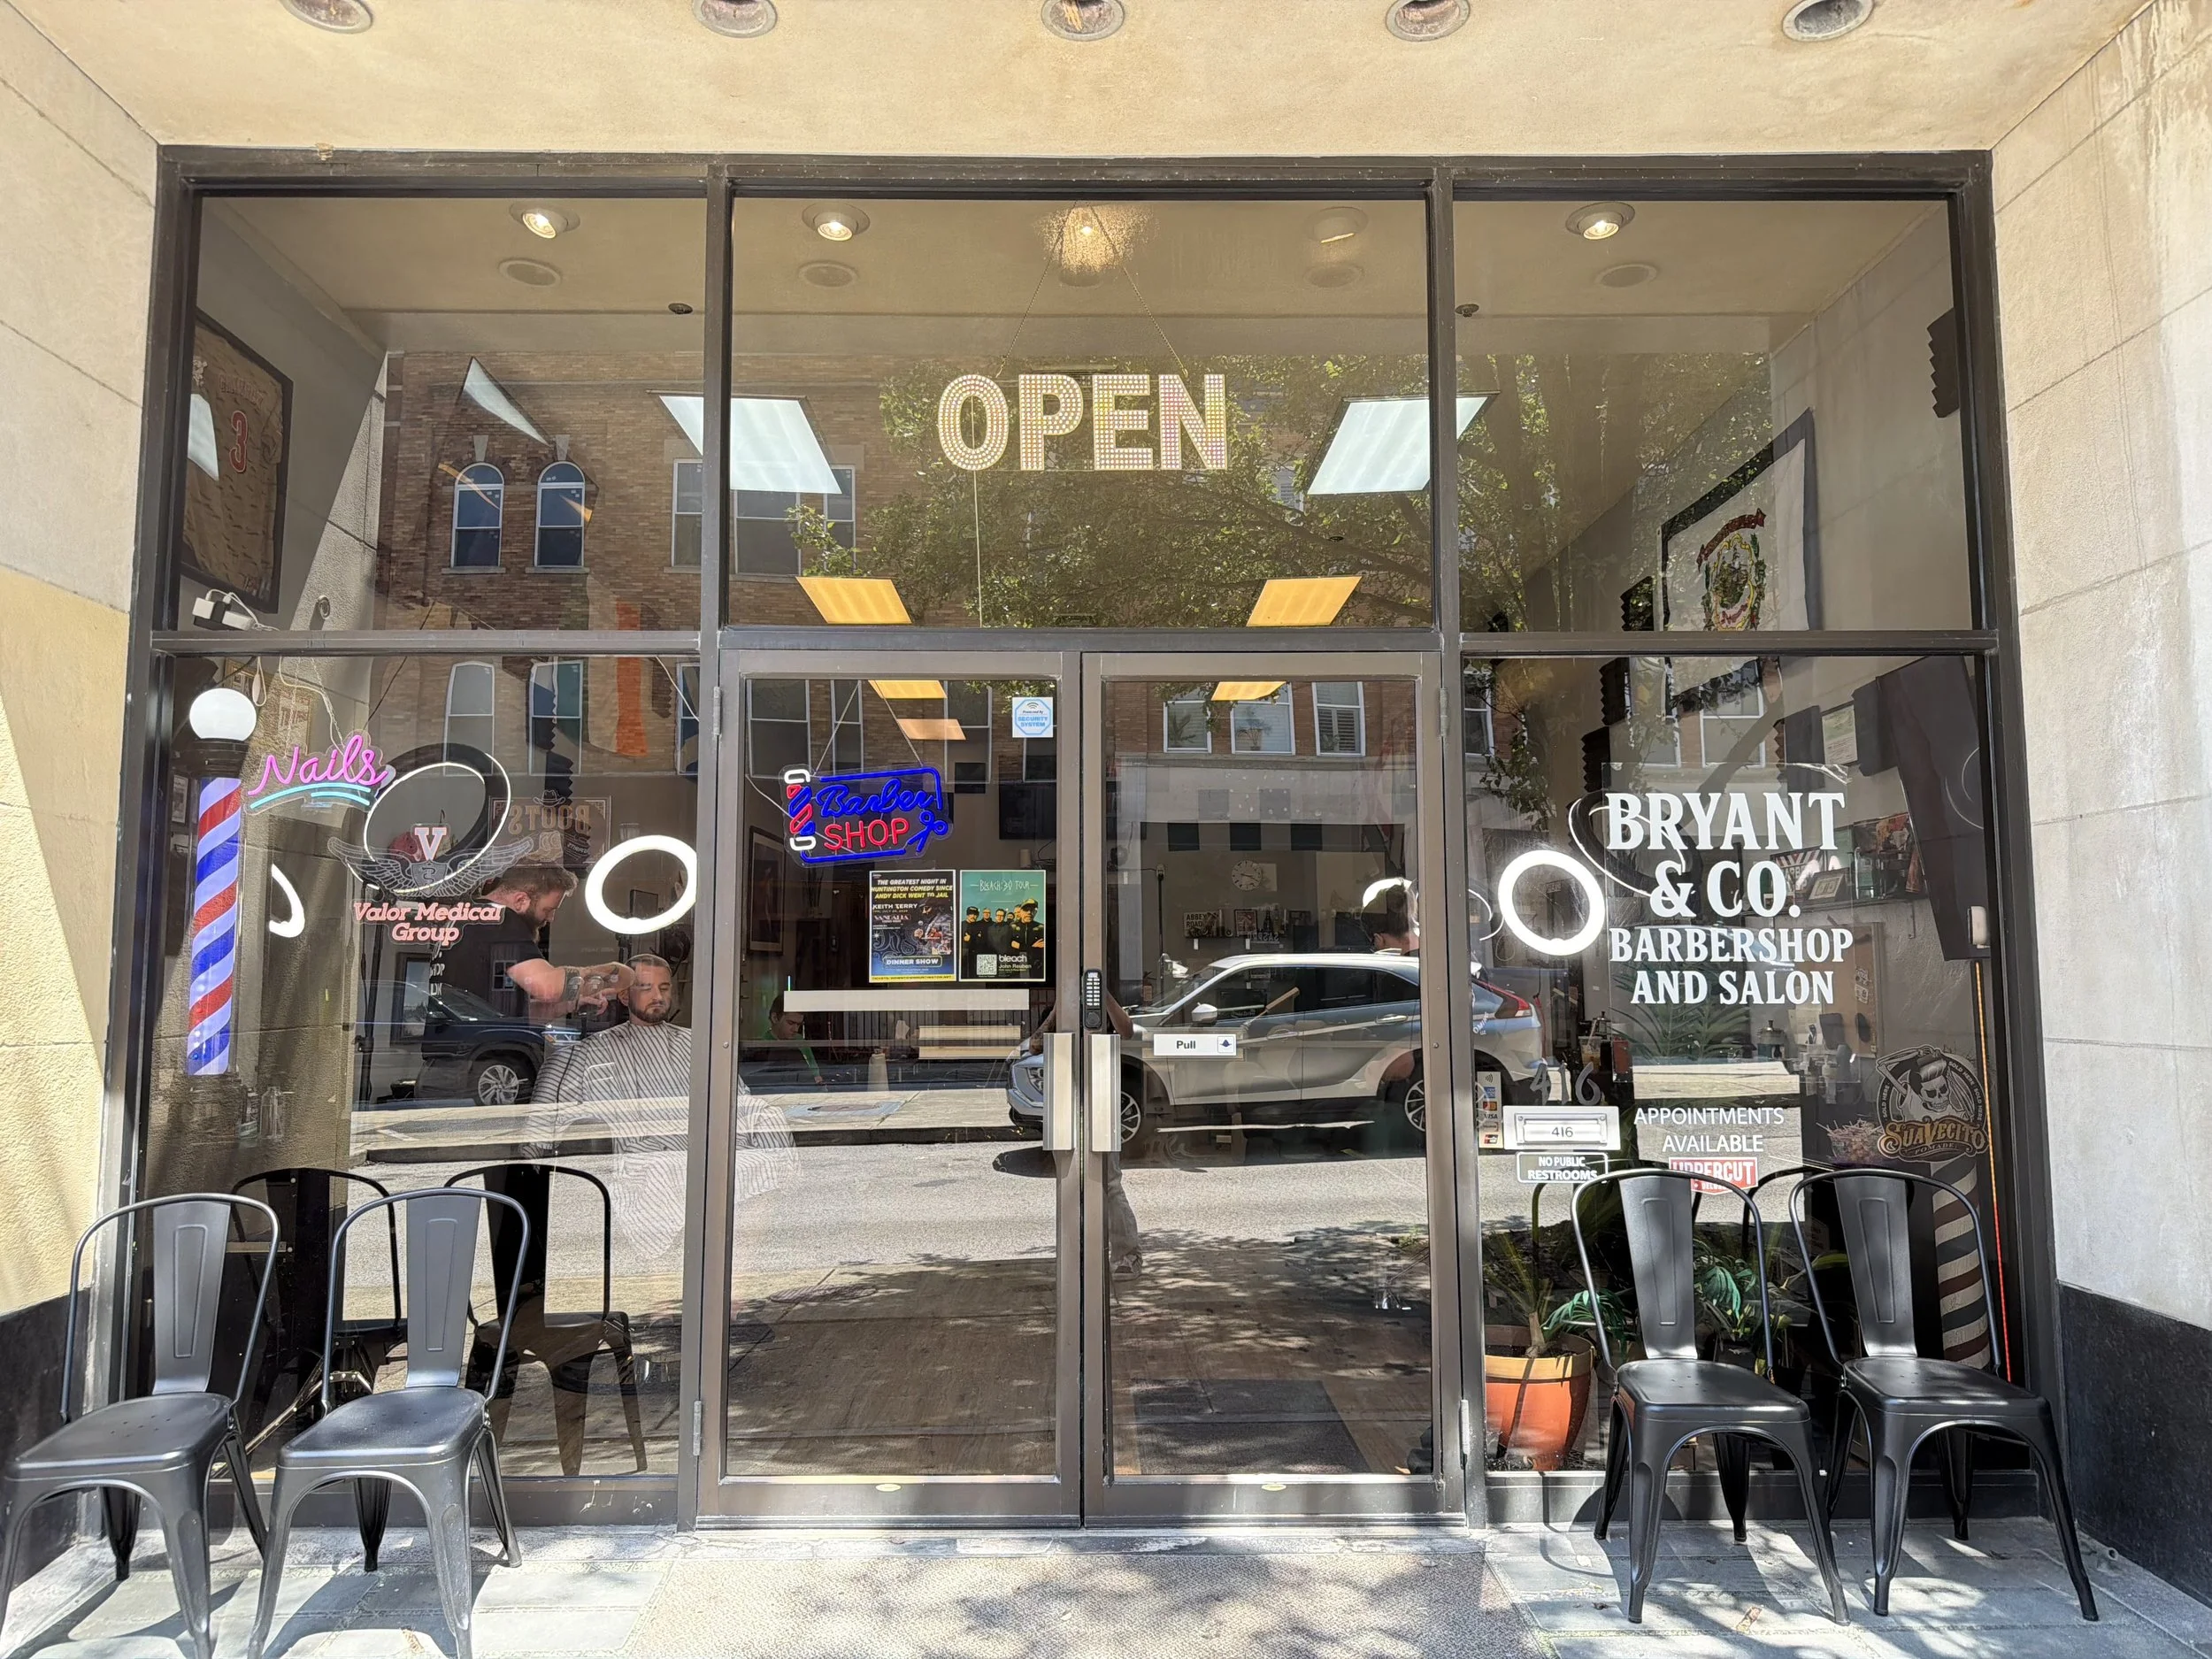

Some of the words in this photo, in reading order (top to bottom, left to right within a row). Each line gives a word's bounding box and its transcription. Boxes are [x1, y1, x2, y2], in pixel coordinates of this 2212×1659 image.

[938, 374, 1228, 470] OPEN
[229, 411, 248, 472] 3
[248, 735, 388, 795] Nails
[815, 778, 933, 818] Barber
[824, 818, 910, 851] SHOP
[1605, 792, 1846, 850] BRYANT
[414, 827, 447, 862] V
[1015, 880, 1030, 890] TOUR
[1649, 860, 1697, 918] &
[1707, 860, 1801, 918] CO.
[354, 902, 411, 922] Valor
[414, 902, 506, 922] Medical
[391, 923, 459, 947] Group
[1609, 927, 1854, 963] BARBERSHOP
[998, 954, 1027, 963] bleach
[1631, 971, 1708, 1004] AND
[1718, 970, 1834, 1005] SALON
[1176, 1040, 1196, 1049] Pull
[1530, 1062, 1601, 1106] 416
[1633, 1107, 1785, 1125] APPOINTMENTS
[1551, 1126, 1574, 1138] 416
[1662, 1134, 1764, 1153] AVAILABLE
[1538, 1156, 1553, 1167] NO
[1554, 1156, 1586, 1167] PUBLIC
[1915, 1142, 1955, 1155] POMADE
[1527, 1170, 1598, 1181] RESTROOMS
